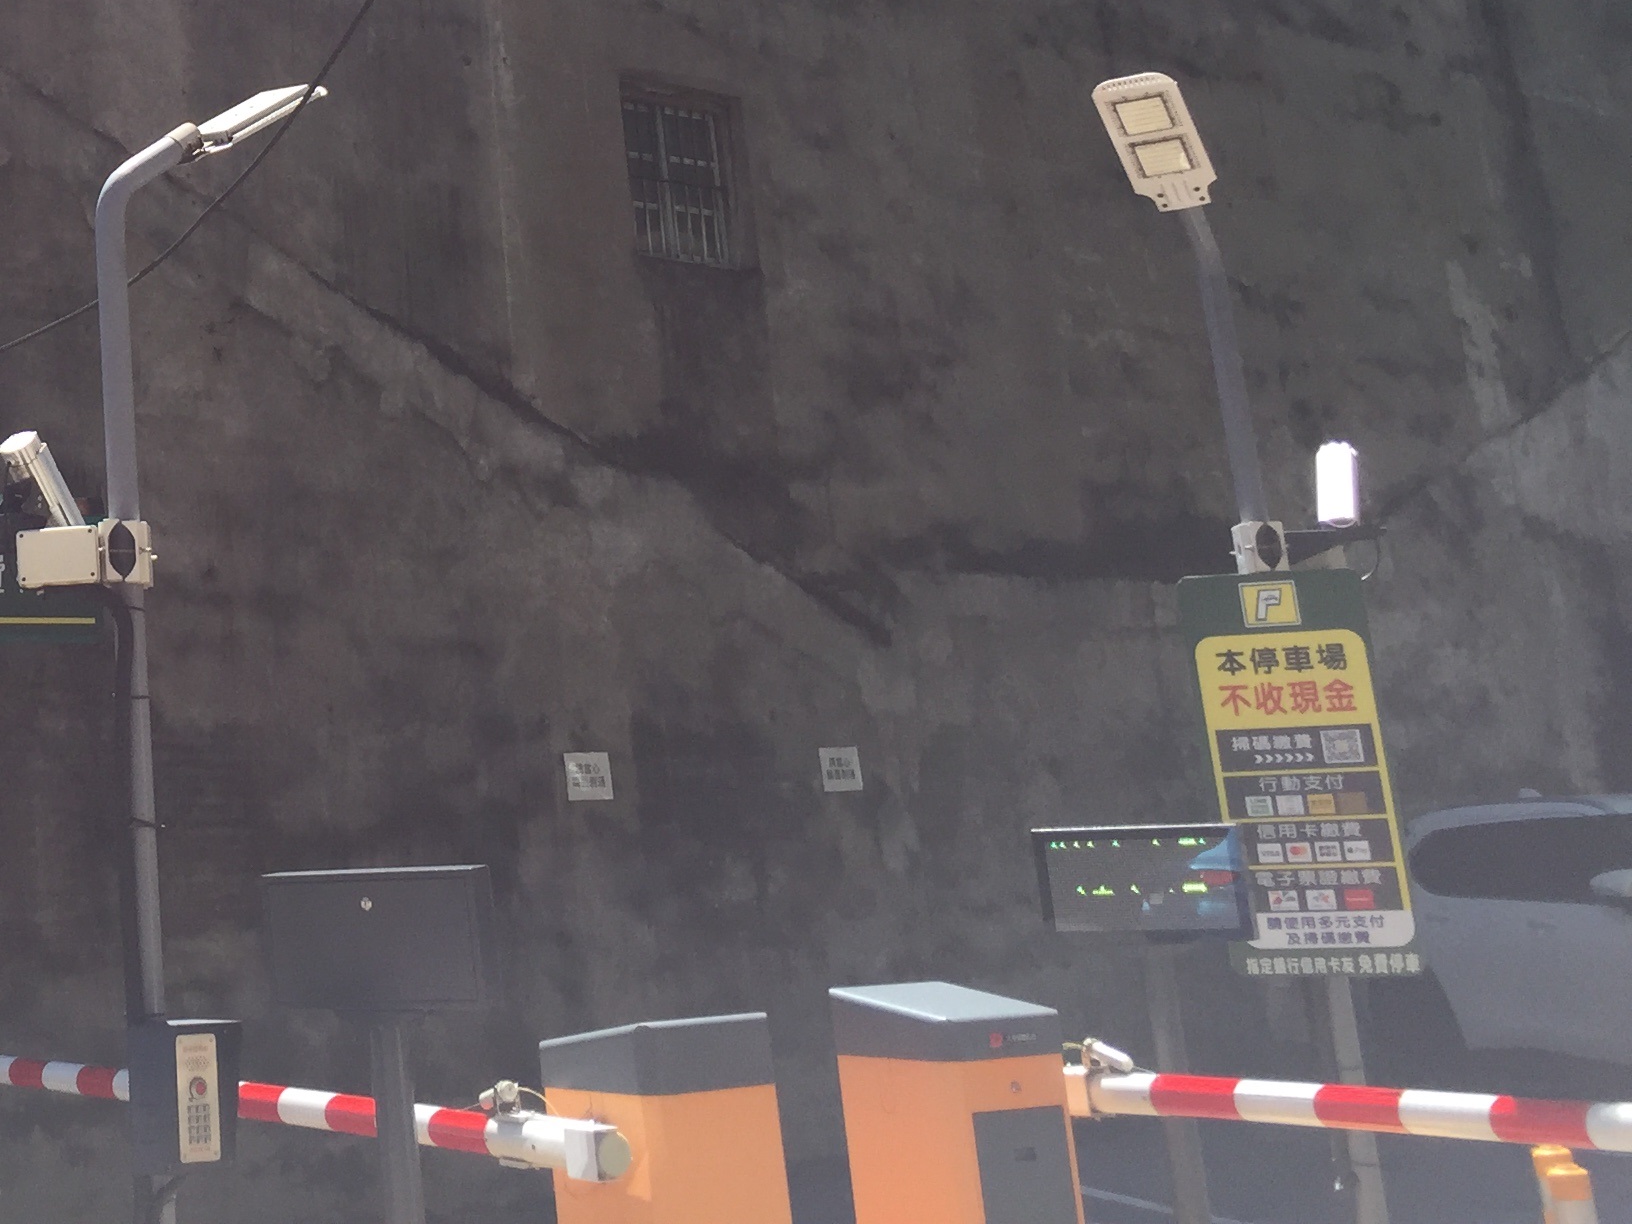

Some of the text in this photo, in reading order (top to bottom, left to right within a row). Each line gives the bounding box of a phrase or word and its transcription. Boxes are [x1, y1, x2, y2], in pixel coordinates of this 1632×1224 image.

[1215, 642, 1348, 676] 本停車場
[1218, 678, 1358, 717] 不收現金
[1231, 733, 1313, 752] 掃碼繳費
[1258, 775, 1345, 792] 行動支付
[1256, 821, 1363, 840] 信用卡繳費
[1256, 869, 1382, 888] 電子票證繳費
